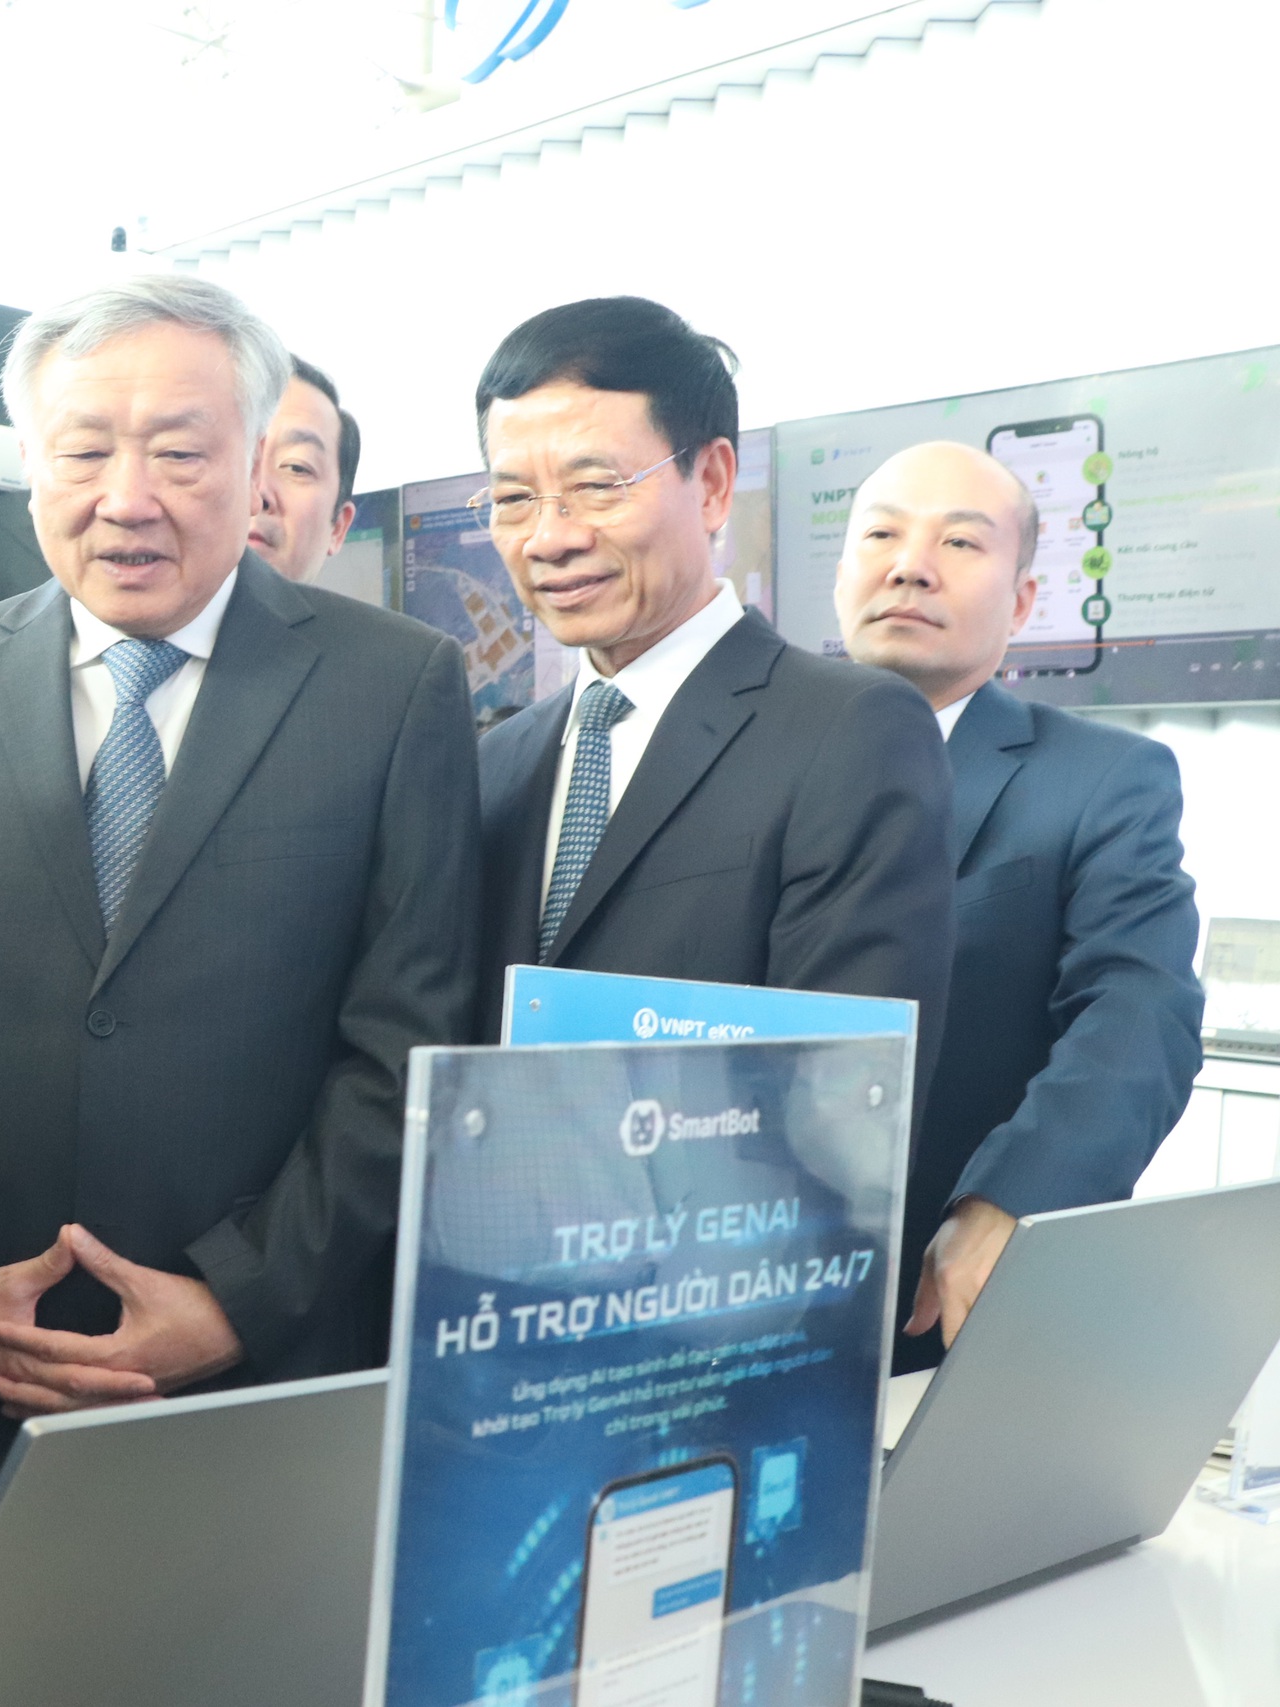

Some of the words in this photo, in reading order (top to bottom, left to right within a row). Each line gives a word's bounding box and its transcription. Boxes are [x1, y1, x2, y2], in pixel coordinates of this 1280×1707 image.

[811, 487, 858, 505] VNPT
[660, 1016, 706, 1038] VNPT
[667, 1108, 760, 1141] SmartBot
[554, 1217, 640, 1264] TRỢ
[645, 1202, 688, 1251] LÝ
[695, 1197, 800, 1243] GENAI
[436, 1292, 500, 1358] HỖ
[510, 1295, 601, 1344] TRỢ
[605, 1267, 719, 1328] NGƯỜI
[728, 1257, 798, 1305] DÂN
[804, 1249, 874, 1292] 24/7
